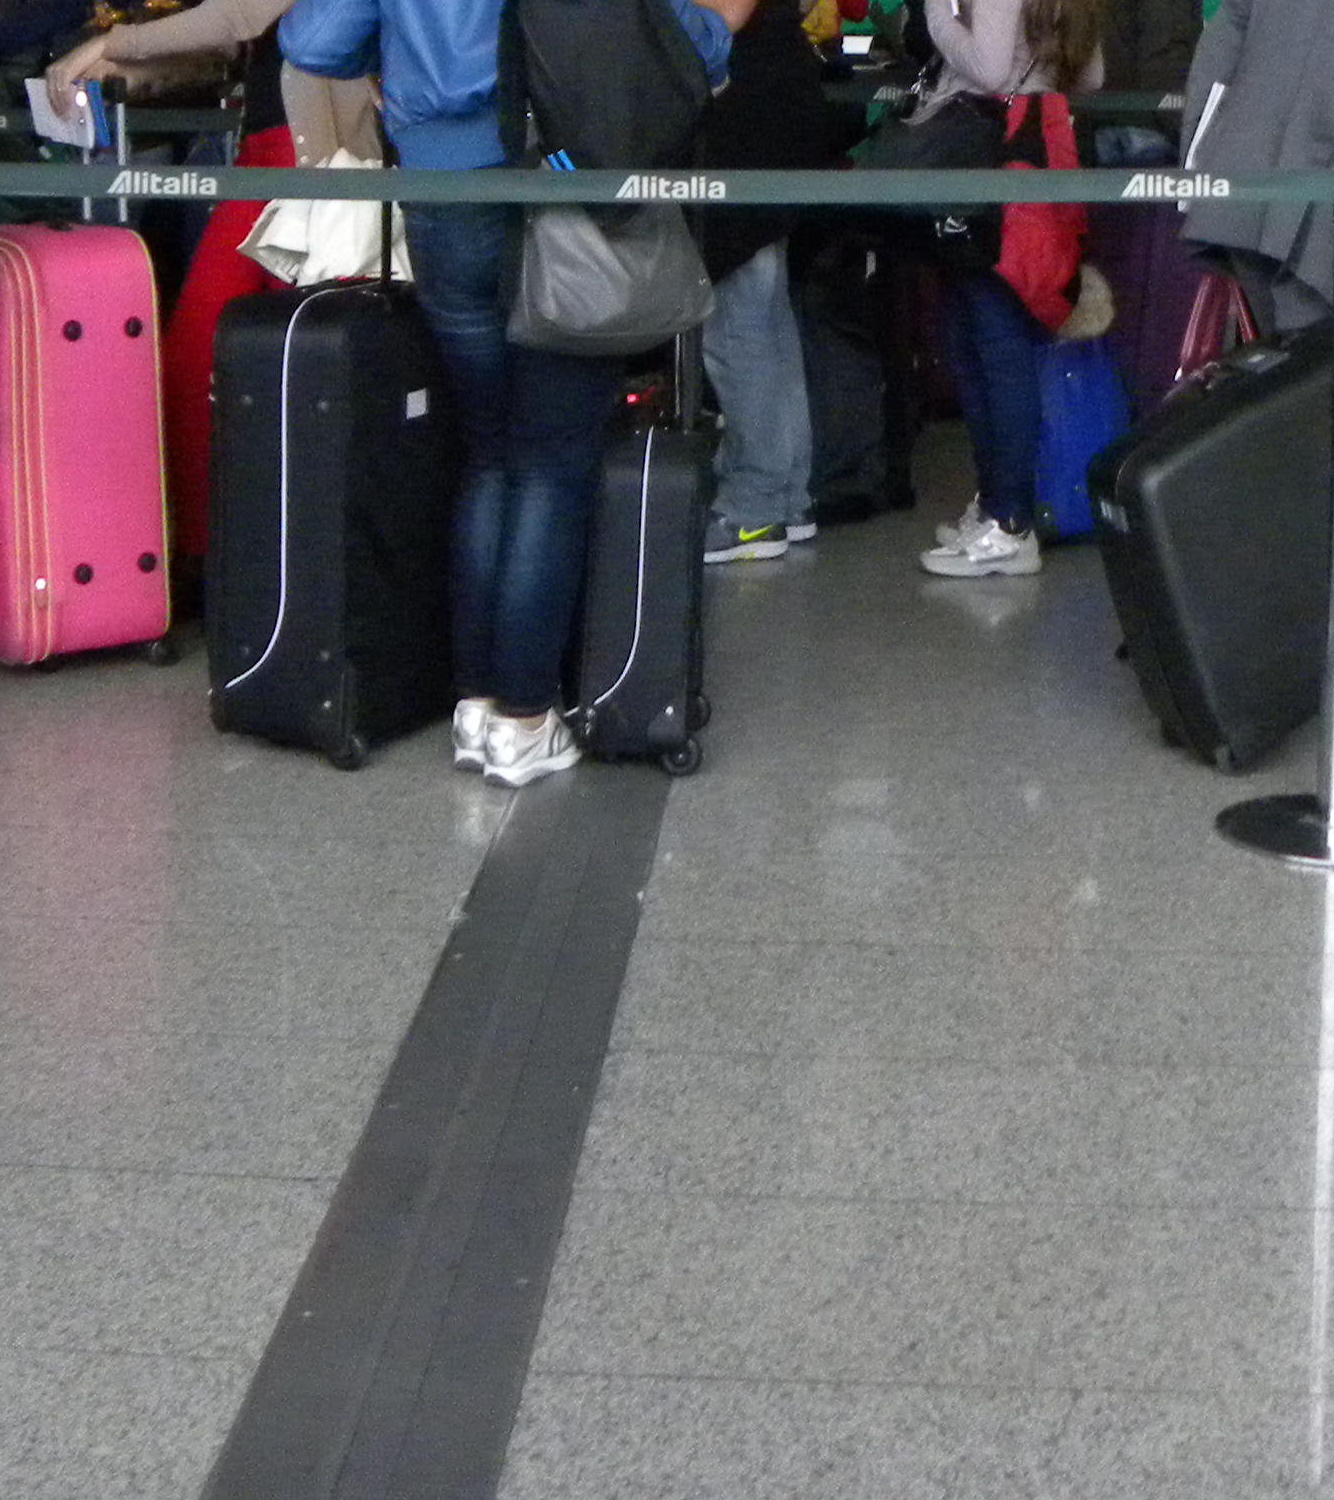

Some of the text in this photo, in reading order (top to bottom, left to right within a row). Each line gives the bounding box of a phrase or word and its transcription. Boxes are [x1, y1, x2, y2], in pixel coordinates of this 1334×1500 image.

[107, 170, 218, 195] Alitalia
[615, 174, 727, 199] Alitalia
[1121, 173, 1231, 198] Alitalia
